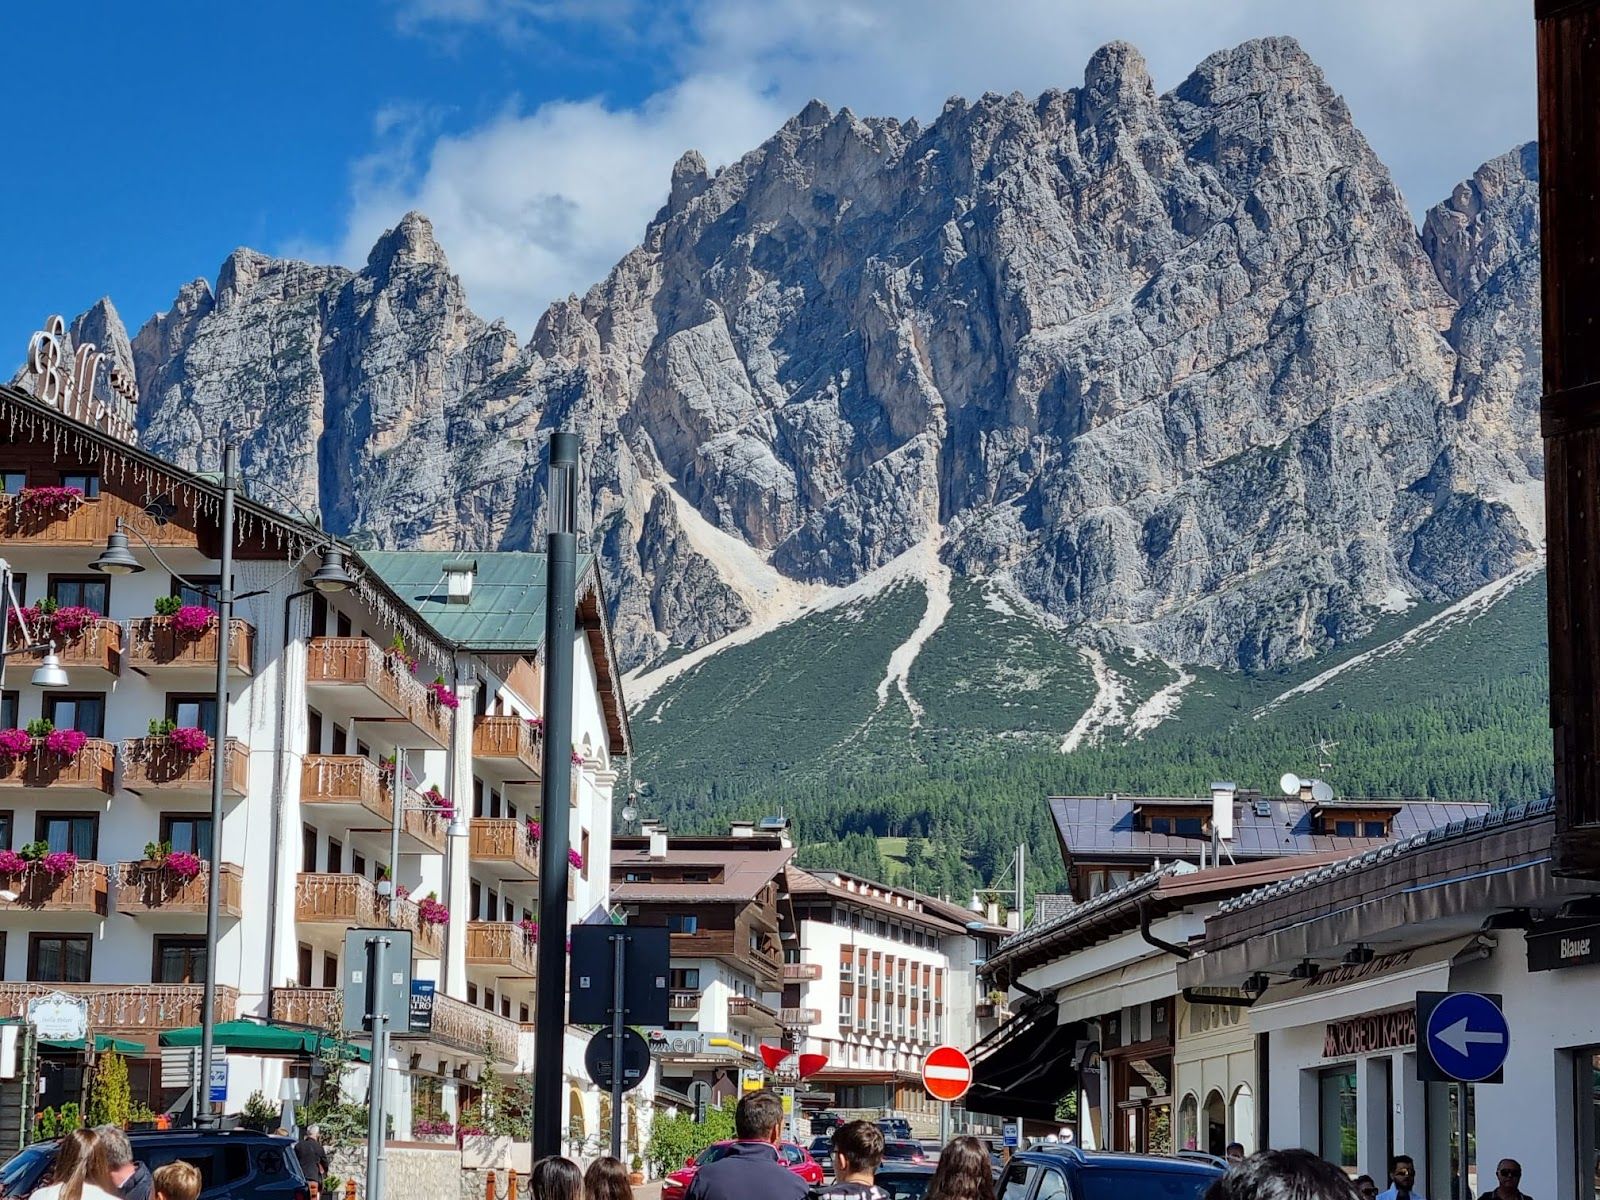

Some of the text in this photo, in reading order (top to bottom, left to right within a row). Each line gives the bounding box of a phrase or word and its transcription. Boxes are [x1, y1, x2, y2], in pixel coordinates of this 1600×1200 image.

[673, 1033, 705, 1054] eni
[1337, 1008, 1417, 1056] ROBE DI KAPPA
